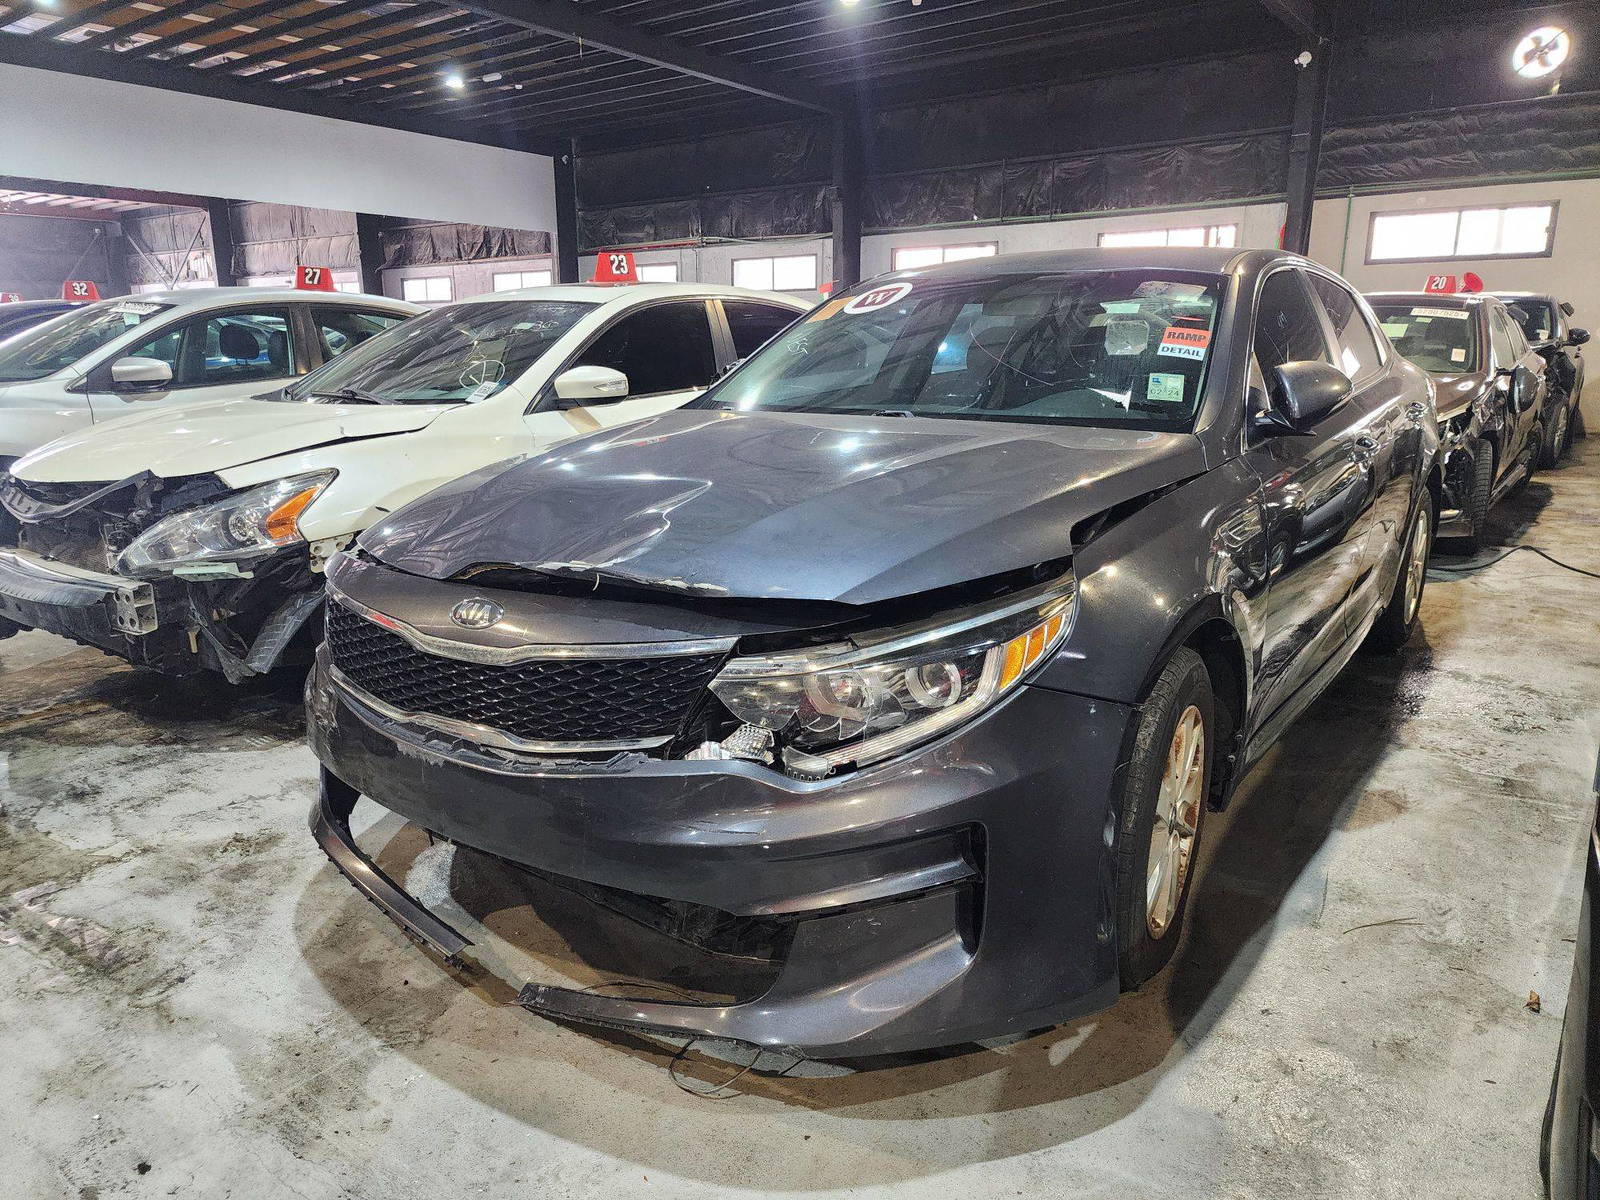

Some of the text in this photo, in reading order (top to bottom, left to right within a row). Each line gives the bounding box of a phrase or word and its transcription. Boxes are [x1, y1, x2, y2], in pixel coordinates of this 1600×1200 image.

[610, 254, 629, 274] 23
[304, 268, 321, 284] 27
[1430, 276, 1447, 290] 20
[72, 282, 89, 296] 32
[1166, 331, 1207, 342] RAMP
[1161, 345, 1202, 357] DETAIL
